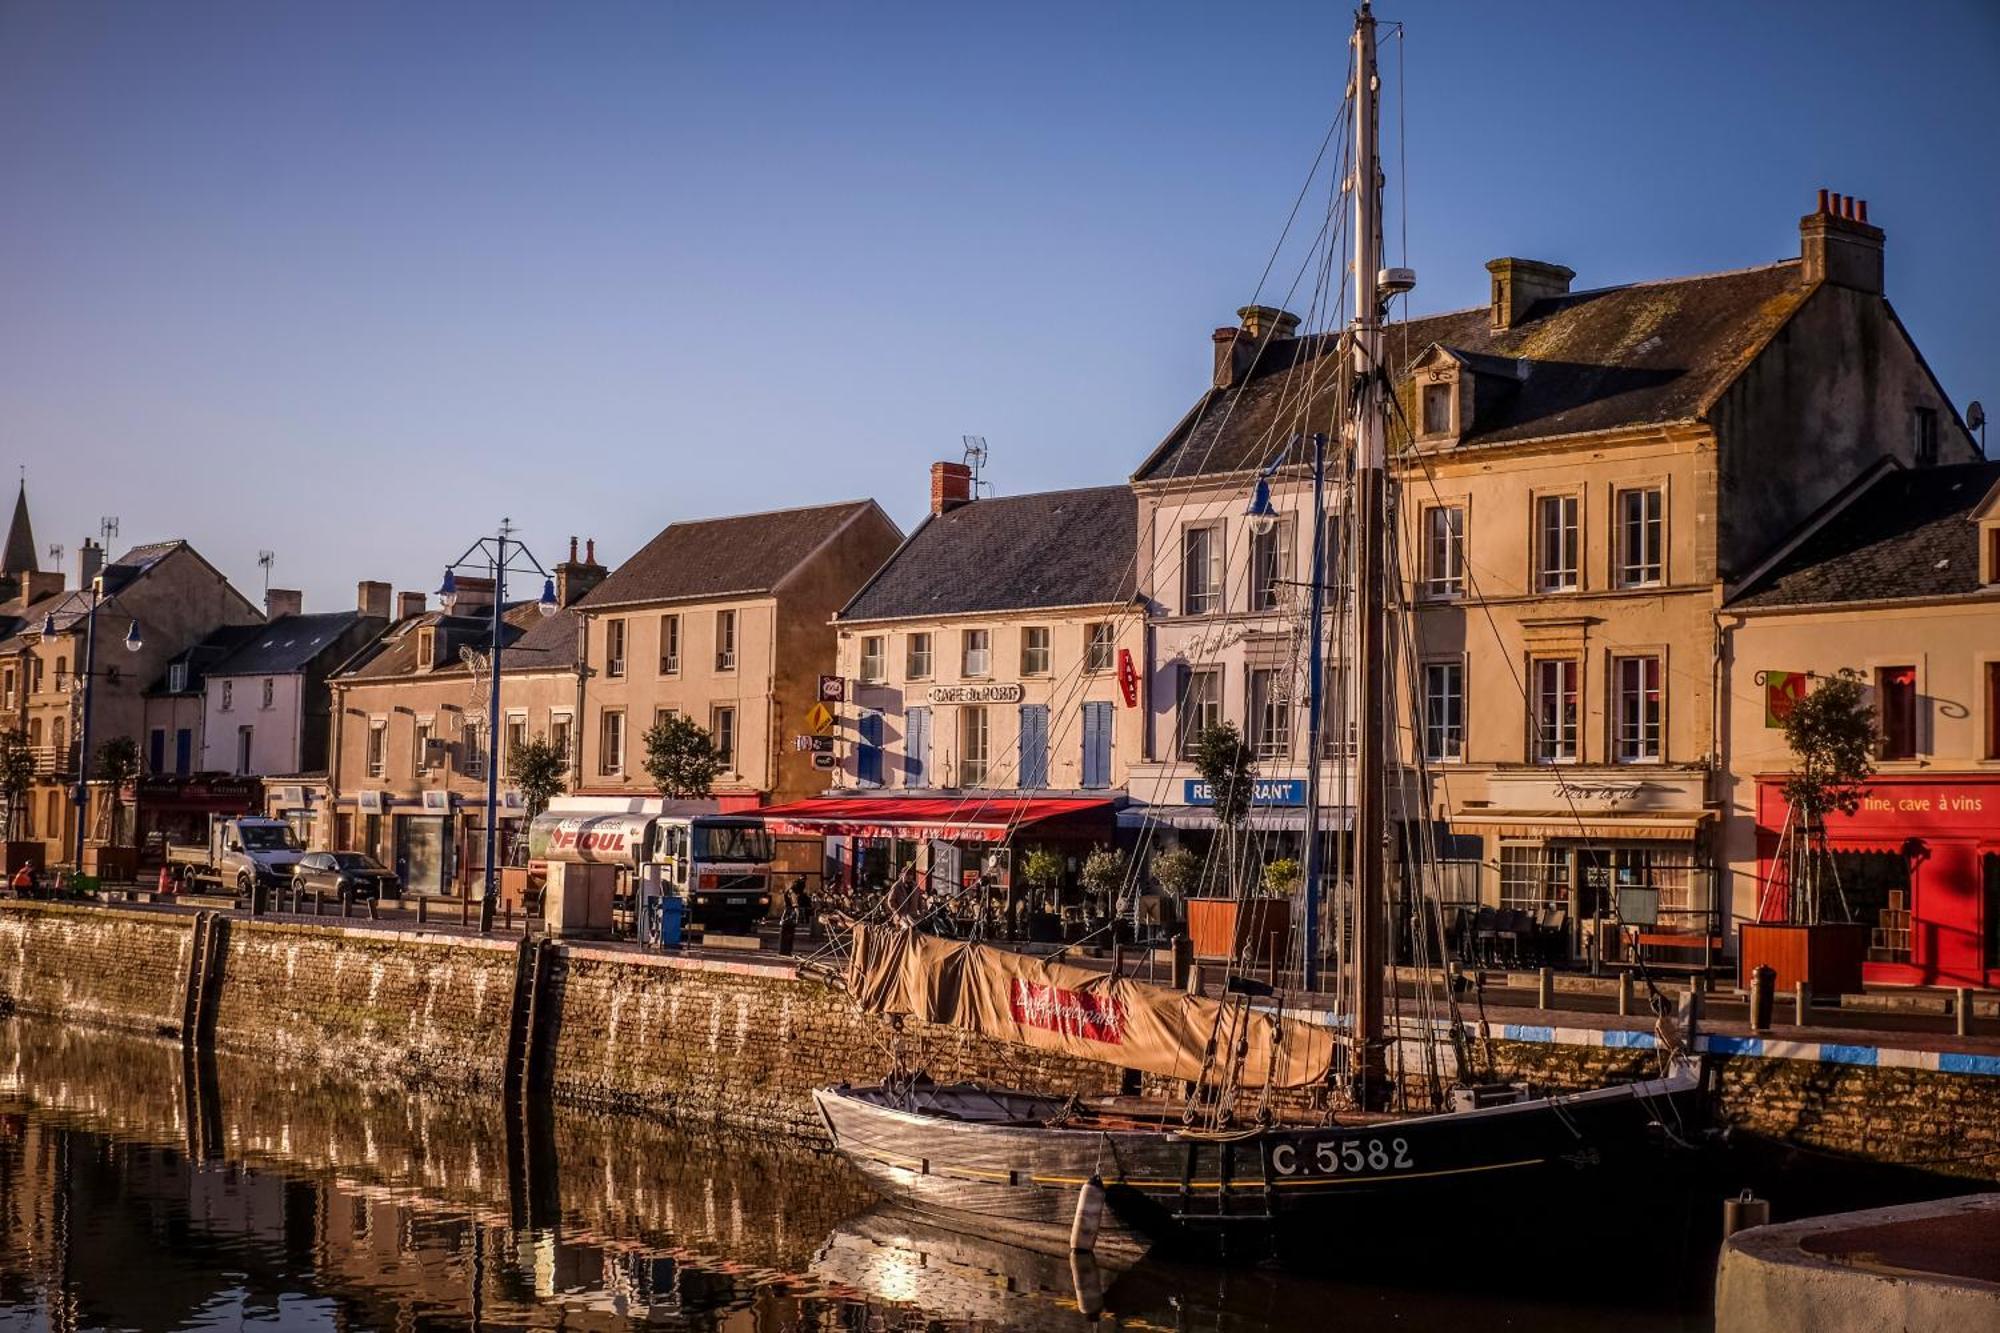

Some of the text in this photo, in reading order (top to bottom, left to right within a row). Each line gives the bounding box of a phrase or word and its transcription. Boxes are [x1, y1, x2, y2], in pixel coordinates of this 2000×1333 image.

[1124, 655, 1136, 701] TABAC
[982, 686, 1018, 701] PORT
[1899, 799, 1930, 811] cave
[1938, 794, 1949, 811] à
[1952, 795, 1982, 811] vins
[559, 832, 625, 851] FIOUL
